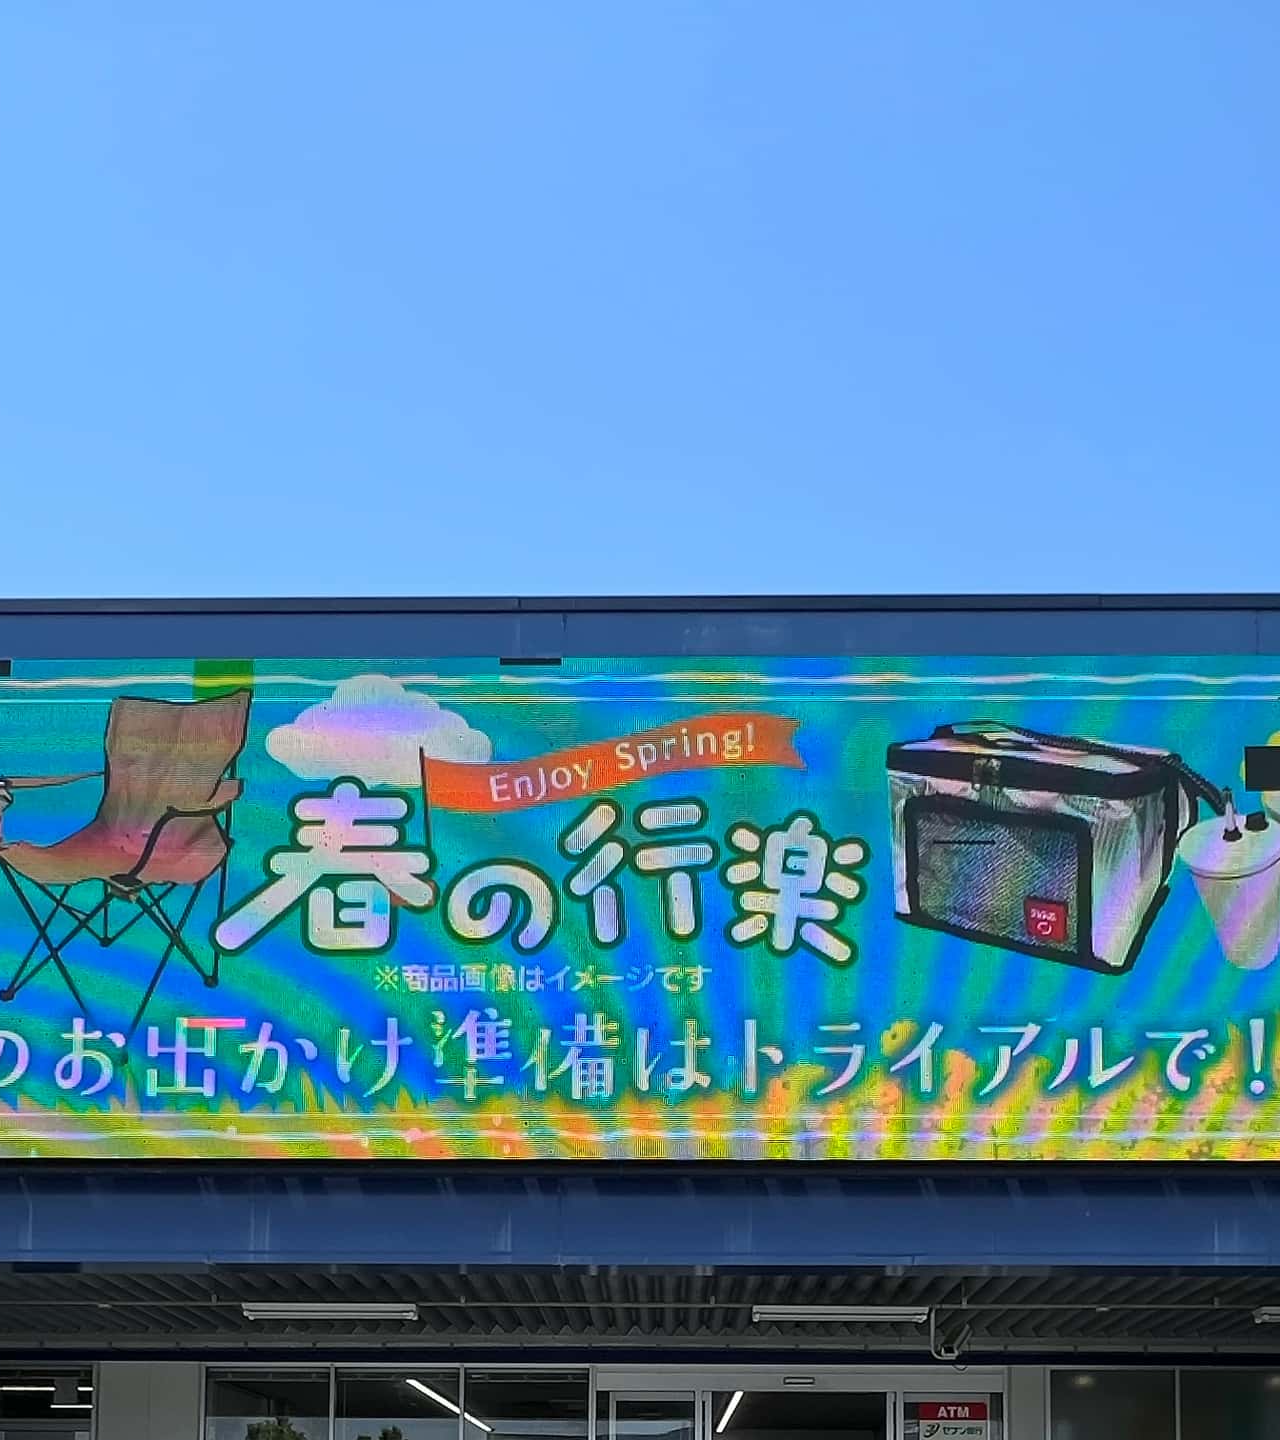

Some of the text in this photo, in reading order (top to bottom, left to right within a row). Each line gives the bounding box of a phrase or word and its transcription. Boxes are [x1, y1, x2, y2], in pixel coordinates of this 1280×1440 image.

[615, 721, 756, 771] Spring!
[210, 778, 859, 966] 春の行楽
[937, 1406, 970, 1418] ATM
